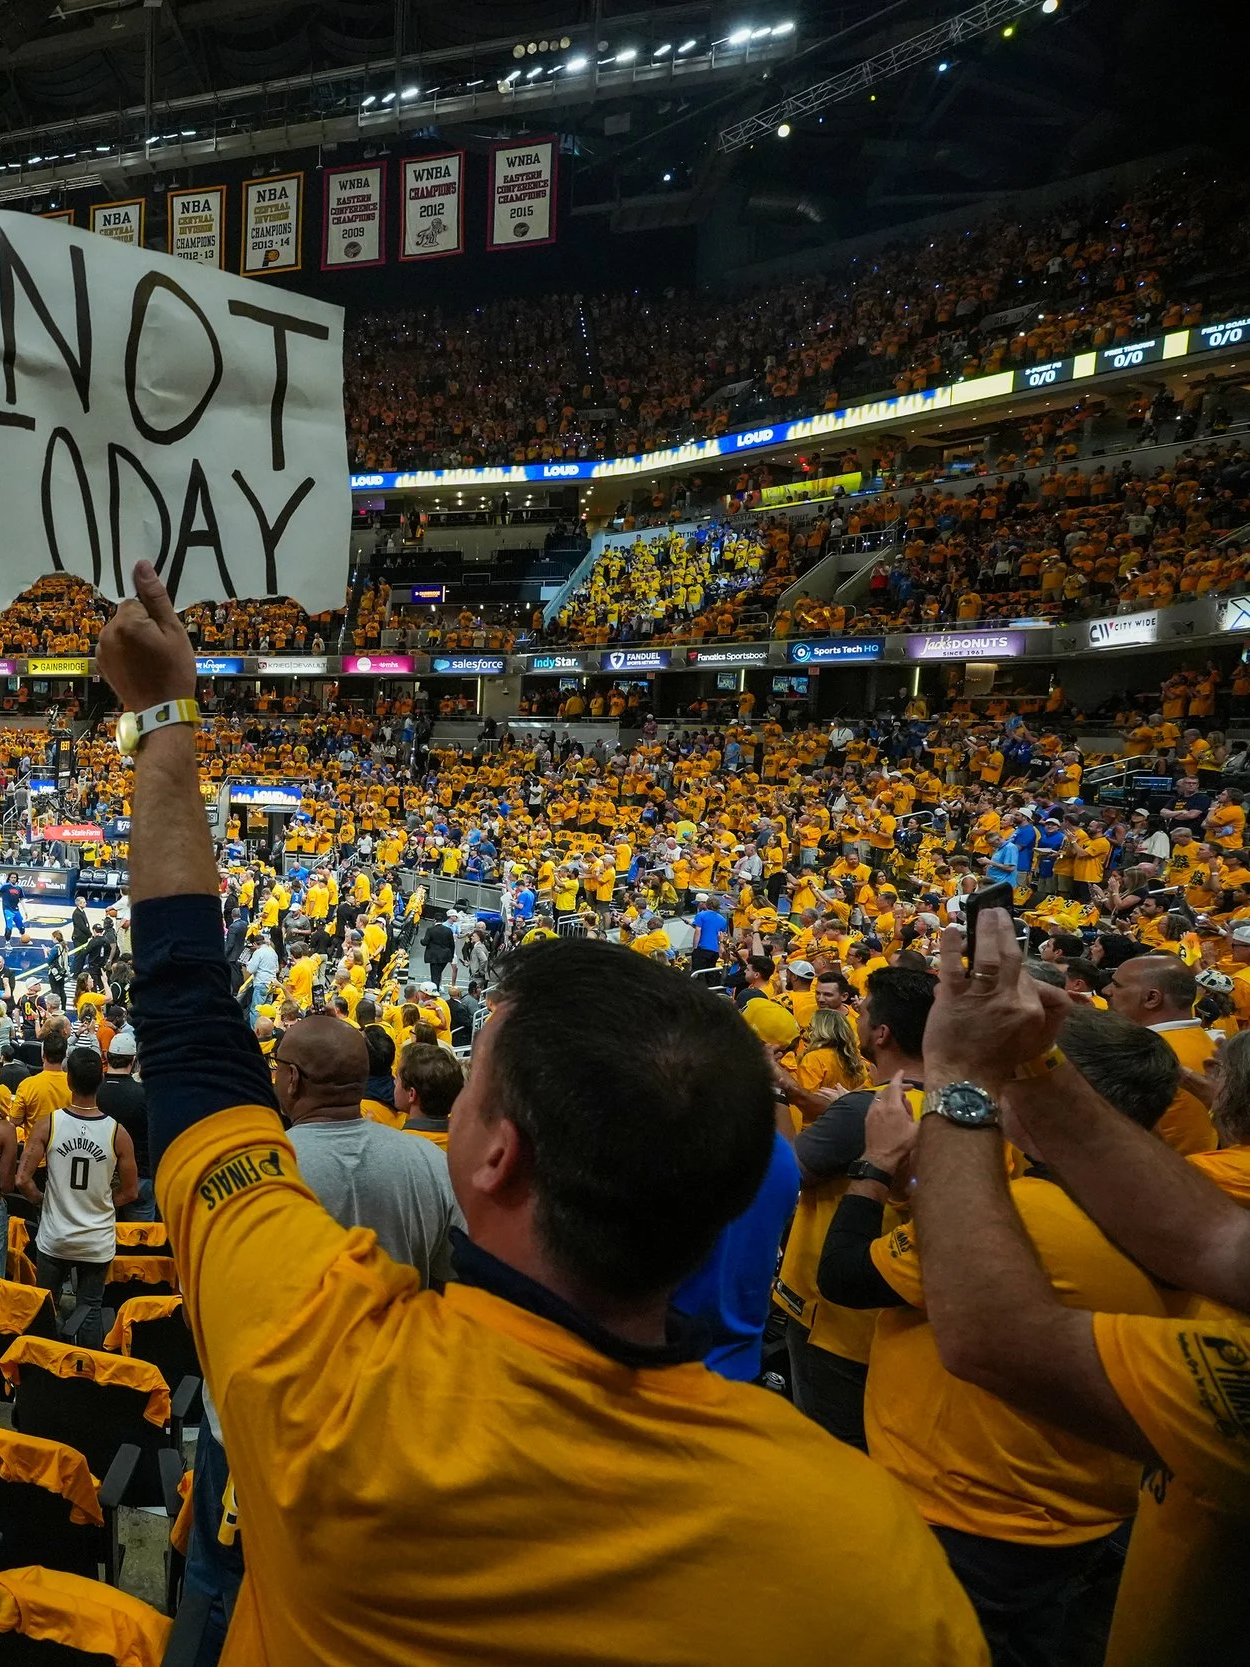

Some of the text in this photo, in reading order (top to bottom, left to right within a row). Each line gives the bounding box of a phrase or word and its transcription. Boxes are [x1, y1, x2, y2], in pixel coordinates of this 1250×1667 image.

[506, 153, 541, 168] WNBA
[413, 165, 452, 182] WNBA
[503, 170, 543, 185] EASTERN
[338, 177, 370, 191] WNBA
[409, 181, 457, 201] CHAMPIONS
[496, 179, 549, 196] CONFERENCE
[257, 186, 289, 204] NBA
[336, 194, 372, 206] EASTERN
[497, 189, 547, 205] CHAMPIONS
[181, 199, 212, 215] NBA
[253, 201, 291, 216] CENTRAL
[331, 202, 378, 216] CONFERENCE
[419, 202, 445, 219] 2012
[509, 205, 534, 219] 2015
[102, 211, 132, 227] NBA
[178, 214, 215, 226] CENTRAL
[254, 211, 290, 225] DIVISION
[332, 213, 376, 225] CHAMPIONS
[99, 226, 134, 238] CENTRAL
[178, 223, 214, 236] DIVISION
[251, 222, 292, 239] CHAMPIONS
[342, 226, 365, 239] 2009
[176, 235, 216, 251] CHAMPIONS
[1209, 328, 1243, 347] 0/0
[1113, 350, 1143, 368] 0/0
[1029, 370, 1056, 387] 0/0
[737, 428, 774, 448] LOUD
[543, 464, 579, 477] LOUD
[351, 474, 384, 487] LOUD
[1114, 617, 1156, 631] CITY WIDE
[813, 644, 879, 657] Sports Tech HQ
[920, 636, 1008, 656] Jack's DONUTS
[533, 656, 579, 669] IndyStar.
[626, 652, 661, 662] FANDUEL
[697, 651, 768, 662] Fanatics Sportsbook
[40, 662, 86, 672] GAINBRIDGE
[203, 660, 227, 673] Kroger
[452, 658, 504, 671] salesforce
[55, 1137, 107, 1164] HALIBURTON
[70, 1155, 90, 1191] 0
[199, 1154, 264, 1212] FINALS
